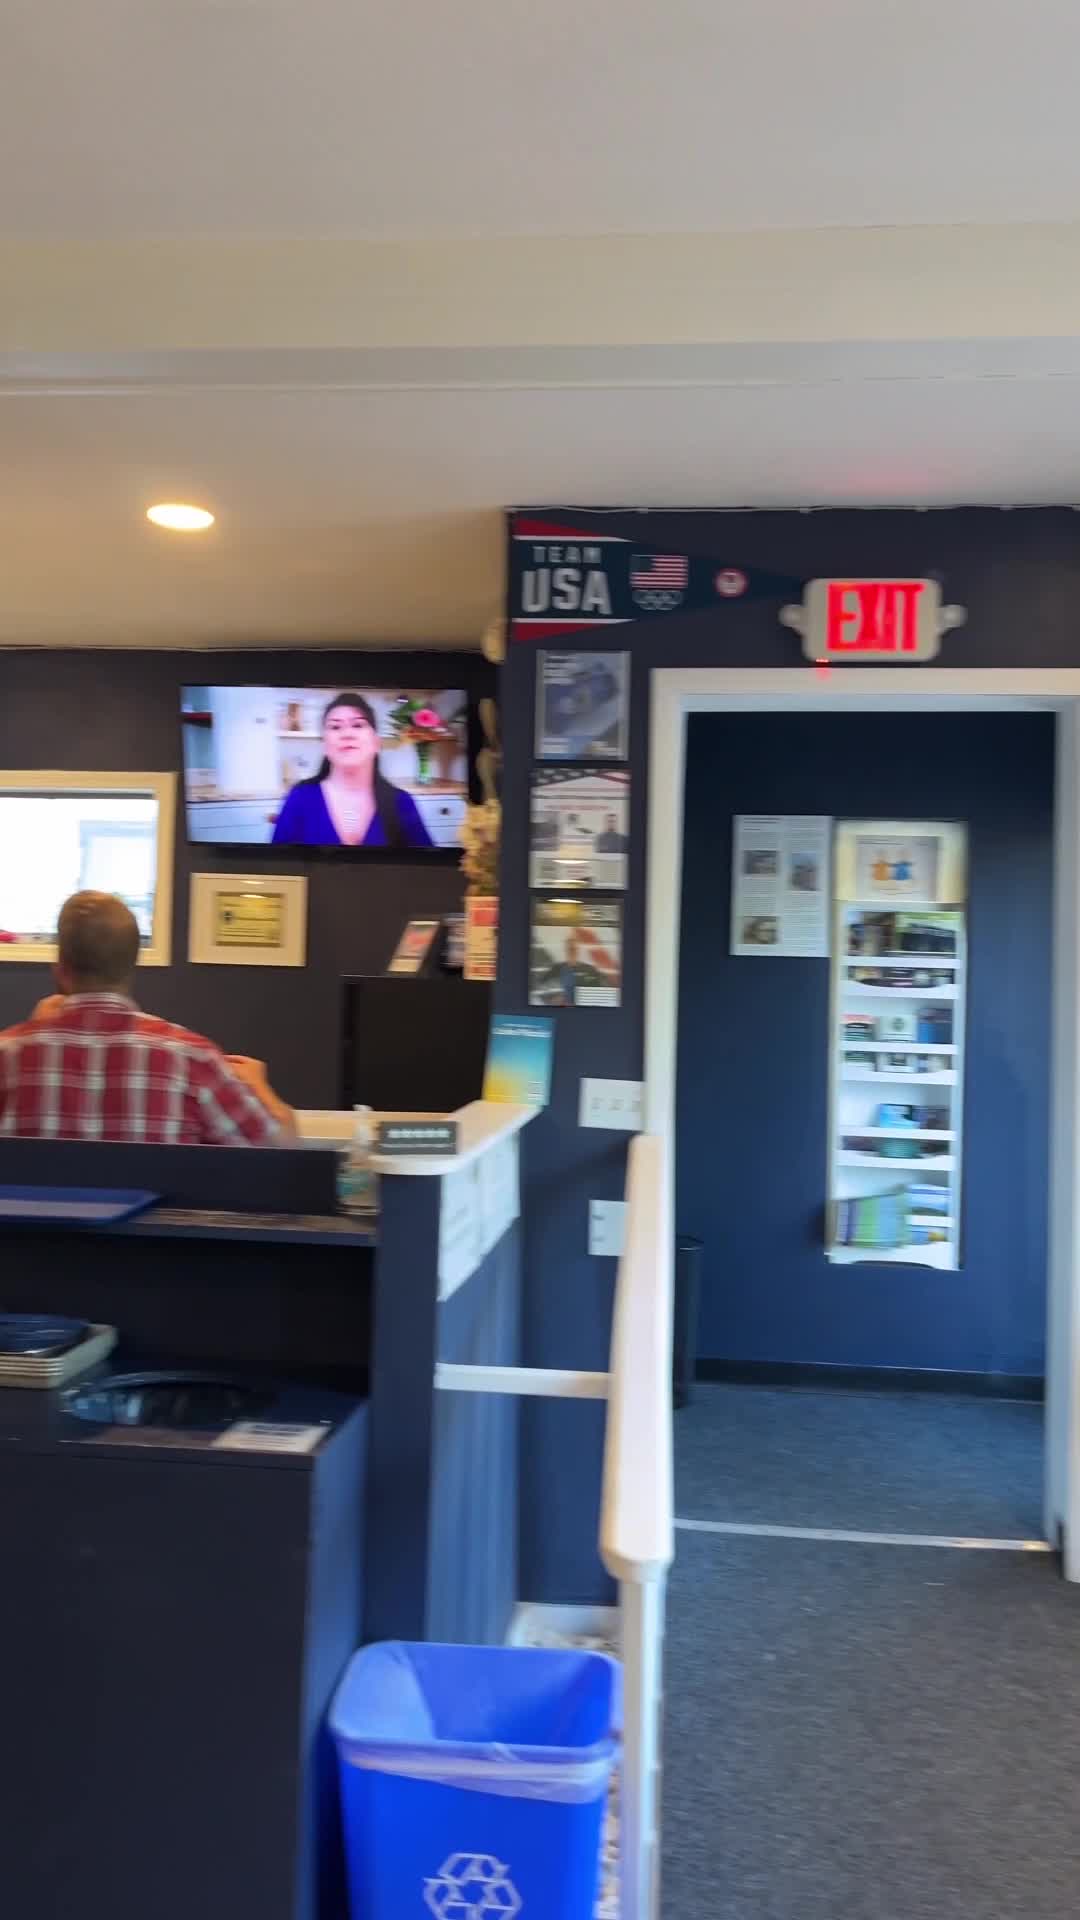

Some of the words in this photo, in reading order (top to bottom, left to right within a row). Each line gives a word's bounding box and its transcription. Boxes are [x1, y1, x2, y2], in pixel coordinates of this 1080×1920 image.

[532, 545, 602, 564] TEAM
[521, 567, 613, 615] USA
[826, 582, 925, 652] EXIT
